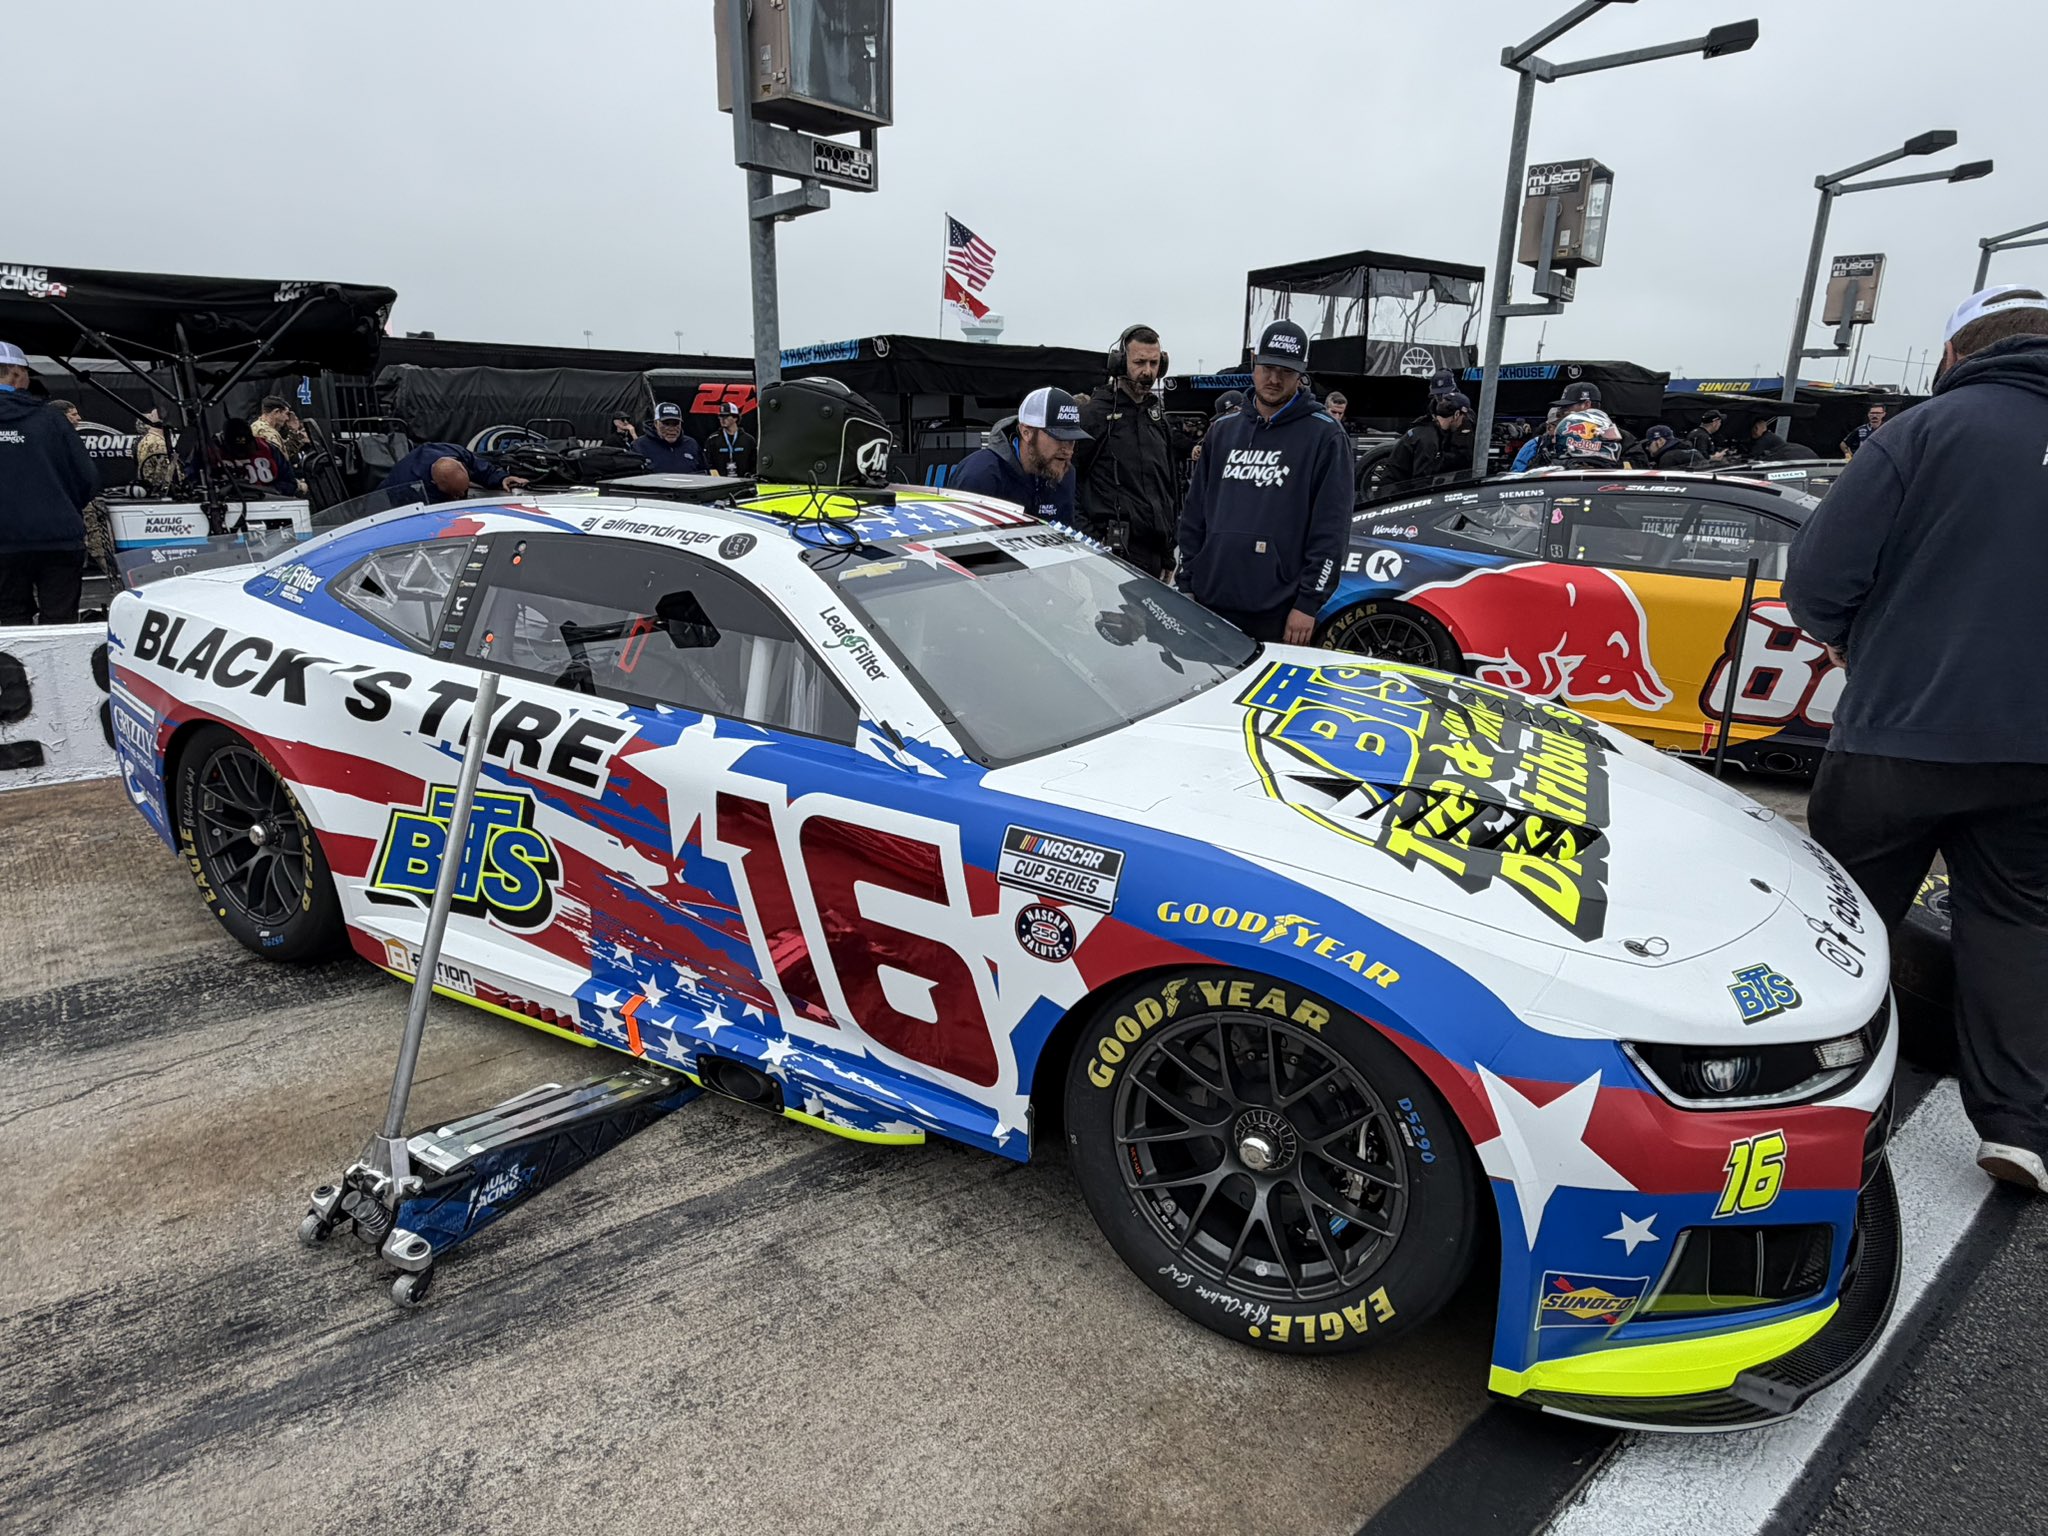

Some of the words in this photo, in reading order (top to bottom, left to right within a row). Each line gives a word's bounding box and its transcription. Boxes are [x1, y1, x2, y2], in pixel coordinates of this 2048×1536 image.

[815, 157, 869, 180] musco
[1528, 172, 1581, 187] musco
[0, 265, 48, 280] ULIG
[1832, 261, 1875, 272] musco
[0, 275, 49, 291] CING
[1272, 334, 1297, 343] KAULIG
[1476, 367, 1545, 379] TCKHOUSE
[1698, 381, 1751, 392] SUNOCO
[89, 449, 133, 458] OTORS
[1227, 449, 1282, 464] KAULIG
[1222, 464, 1276, 481] RACING
[1499, 489, 1545, 499] SIEMENS
[1625, 485, 1687, 493] ZILISCH
[1352, 498, 1433, 522] OTO-ROOTER
[145, 525, 180, 533] RACING
[147, 517, 182, 525] KAULIG
[581, 516, 603, 531] aj
[602, 517, 721, 546] allmendinger
[1372, 525, 1404, 536] Wendy's
[1708, 525, 1748, 538] FAMILY
[288, 565, 325, 593] Filter
[1315, 559, 1334, 591] KAULIG
[819, 606, 855, 638] Leaf
[849, 643, 889, 681] Filter
[373, 786, 556, 918] BTS
[1038, 839, 1105, 869] NASCAR
[180, 826, 218, 904] EAGLE
[1014, 860, 1045, 879] CUP
[1044, 867, 1099, 894] SERIES
[1025, 909, 1069, 932] NASCAR
[714, 790, 1000, 1088] 16
[1032, 925, 1059, 941] 250
[1021, 934, 1068, 958] SALUTES
[1729, 963, 1801, 1023] BTS
[1398, 1097, 1437, 1164] D5290
[1713, 1129, 1786, 1218] 16
[1542, 1294, 1637, 1311] SUNOCO
[1268, 1285, 1397, 1343] EAGLE
